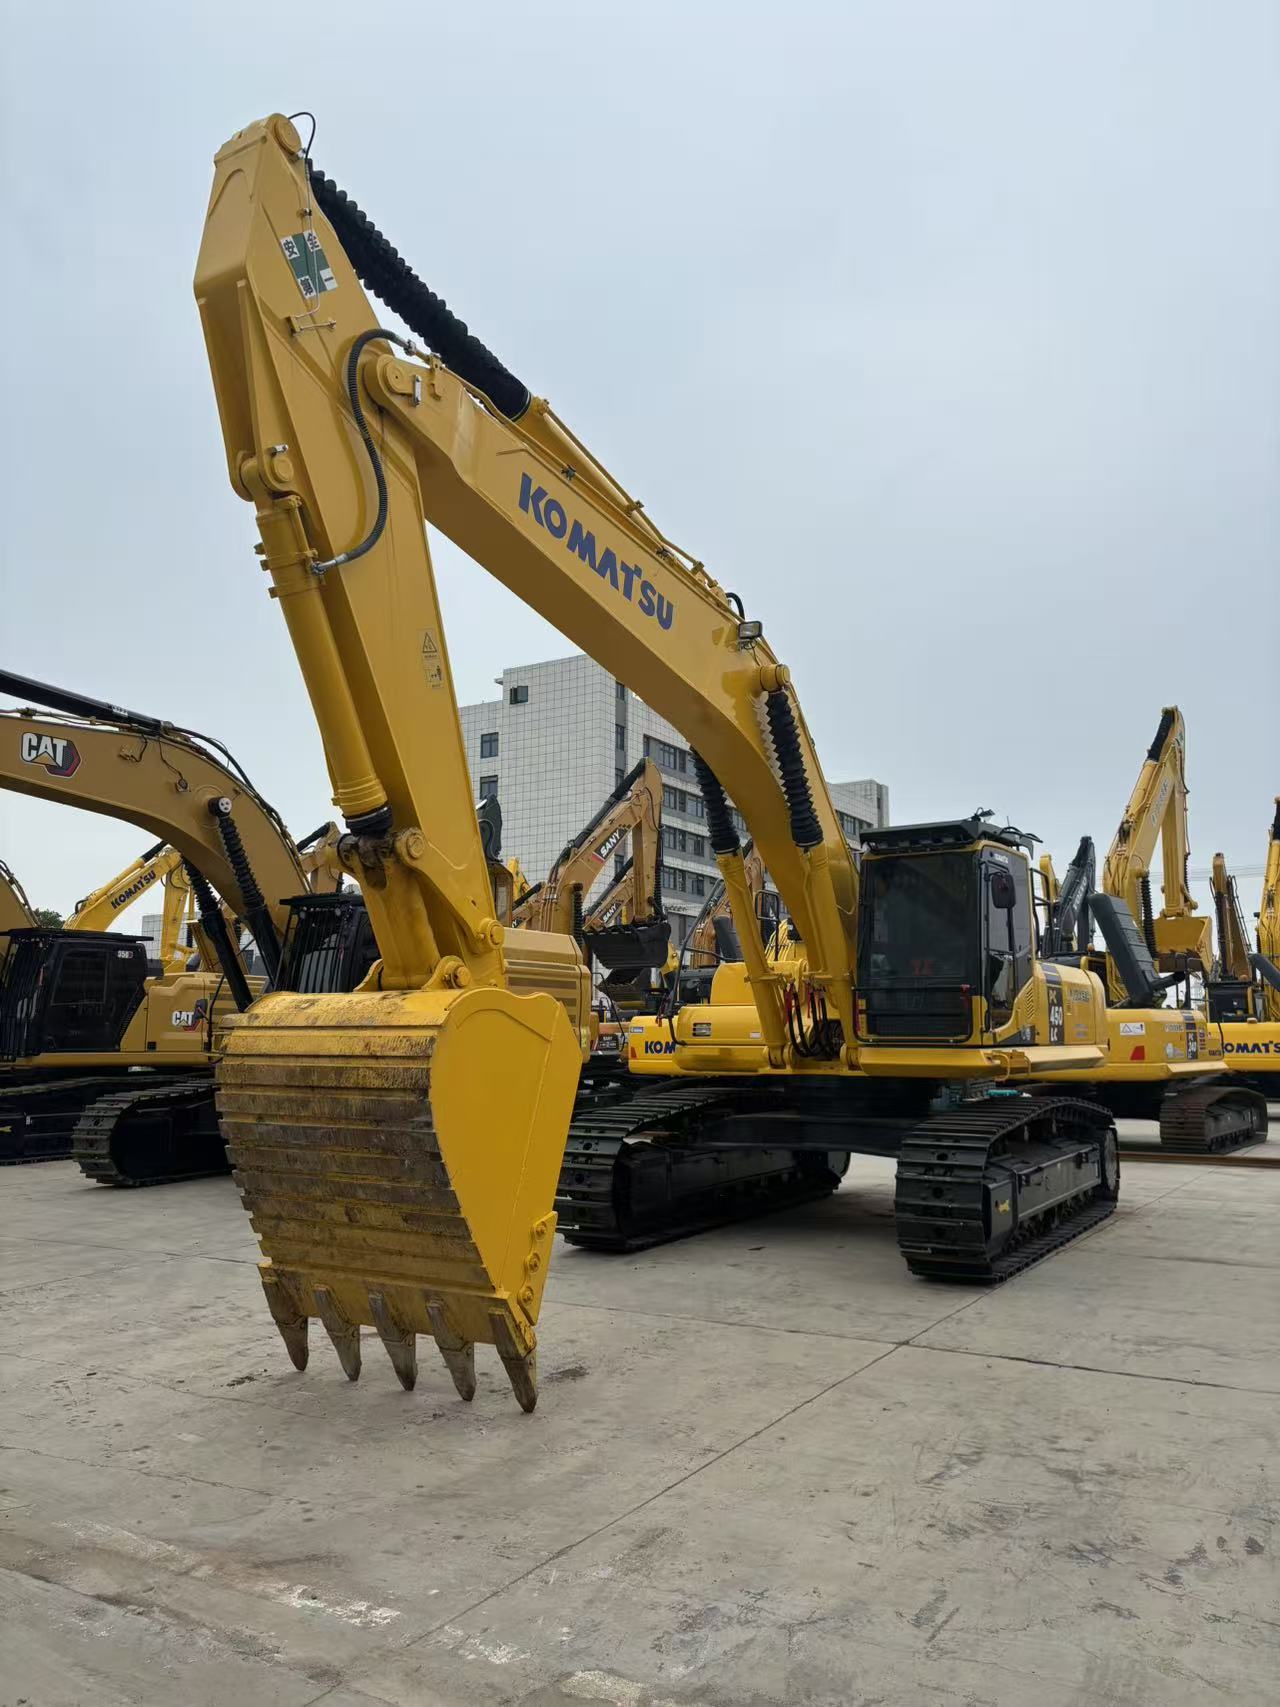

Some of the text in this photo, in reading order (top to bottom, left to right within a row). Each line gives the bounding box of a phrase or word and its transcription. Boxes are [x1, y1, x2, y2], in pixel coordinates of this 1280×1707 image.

[518, 471, 674, 630] KOMATSU
[22, 732, 68, 767] CAT
[600, 829, 621, 858] SANY
[110, 869, 156, 910] KOMATSU
[172, 1010, 195, 1027] CAT
[1049, 1005, 1063, 1026] 450
[1050, 1026, 1059, 1042] LC
